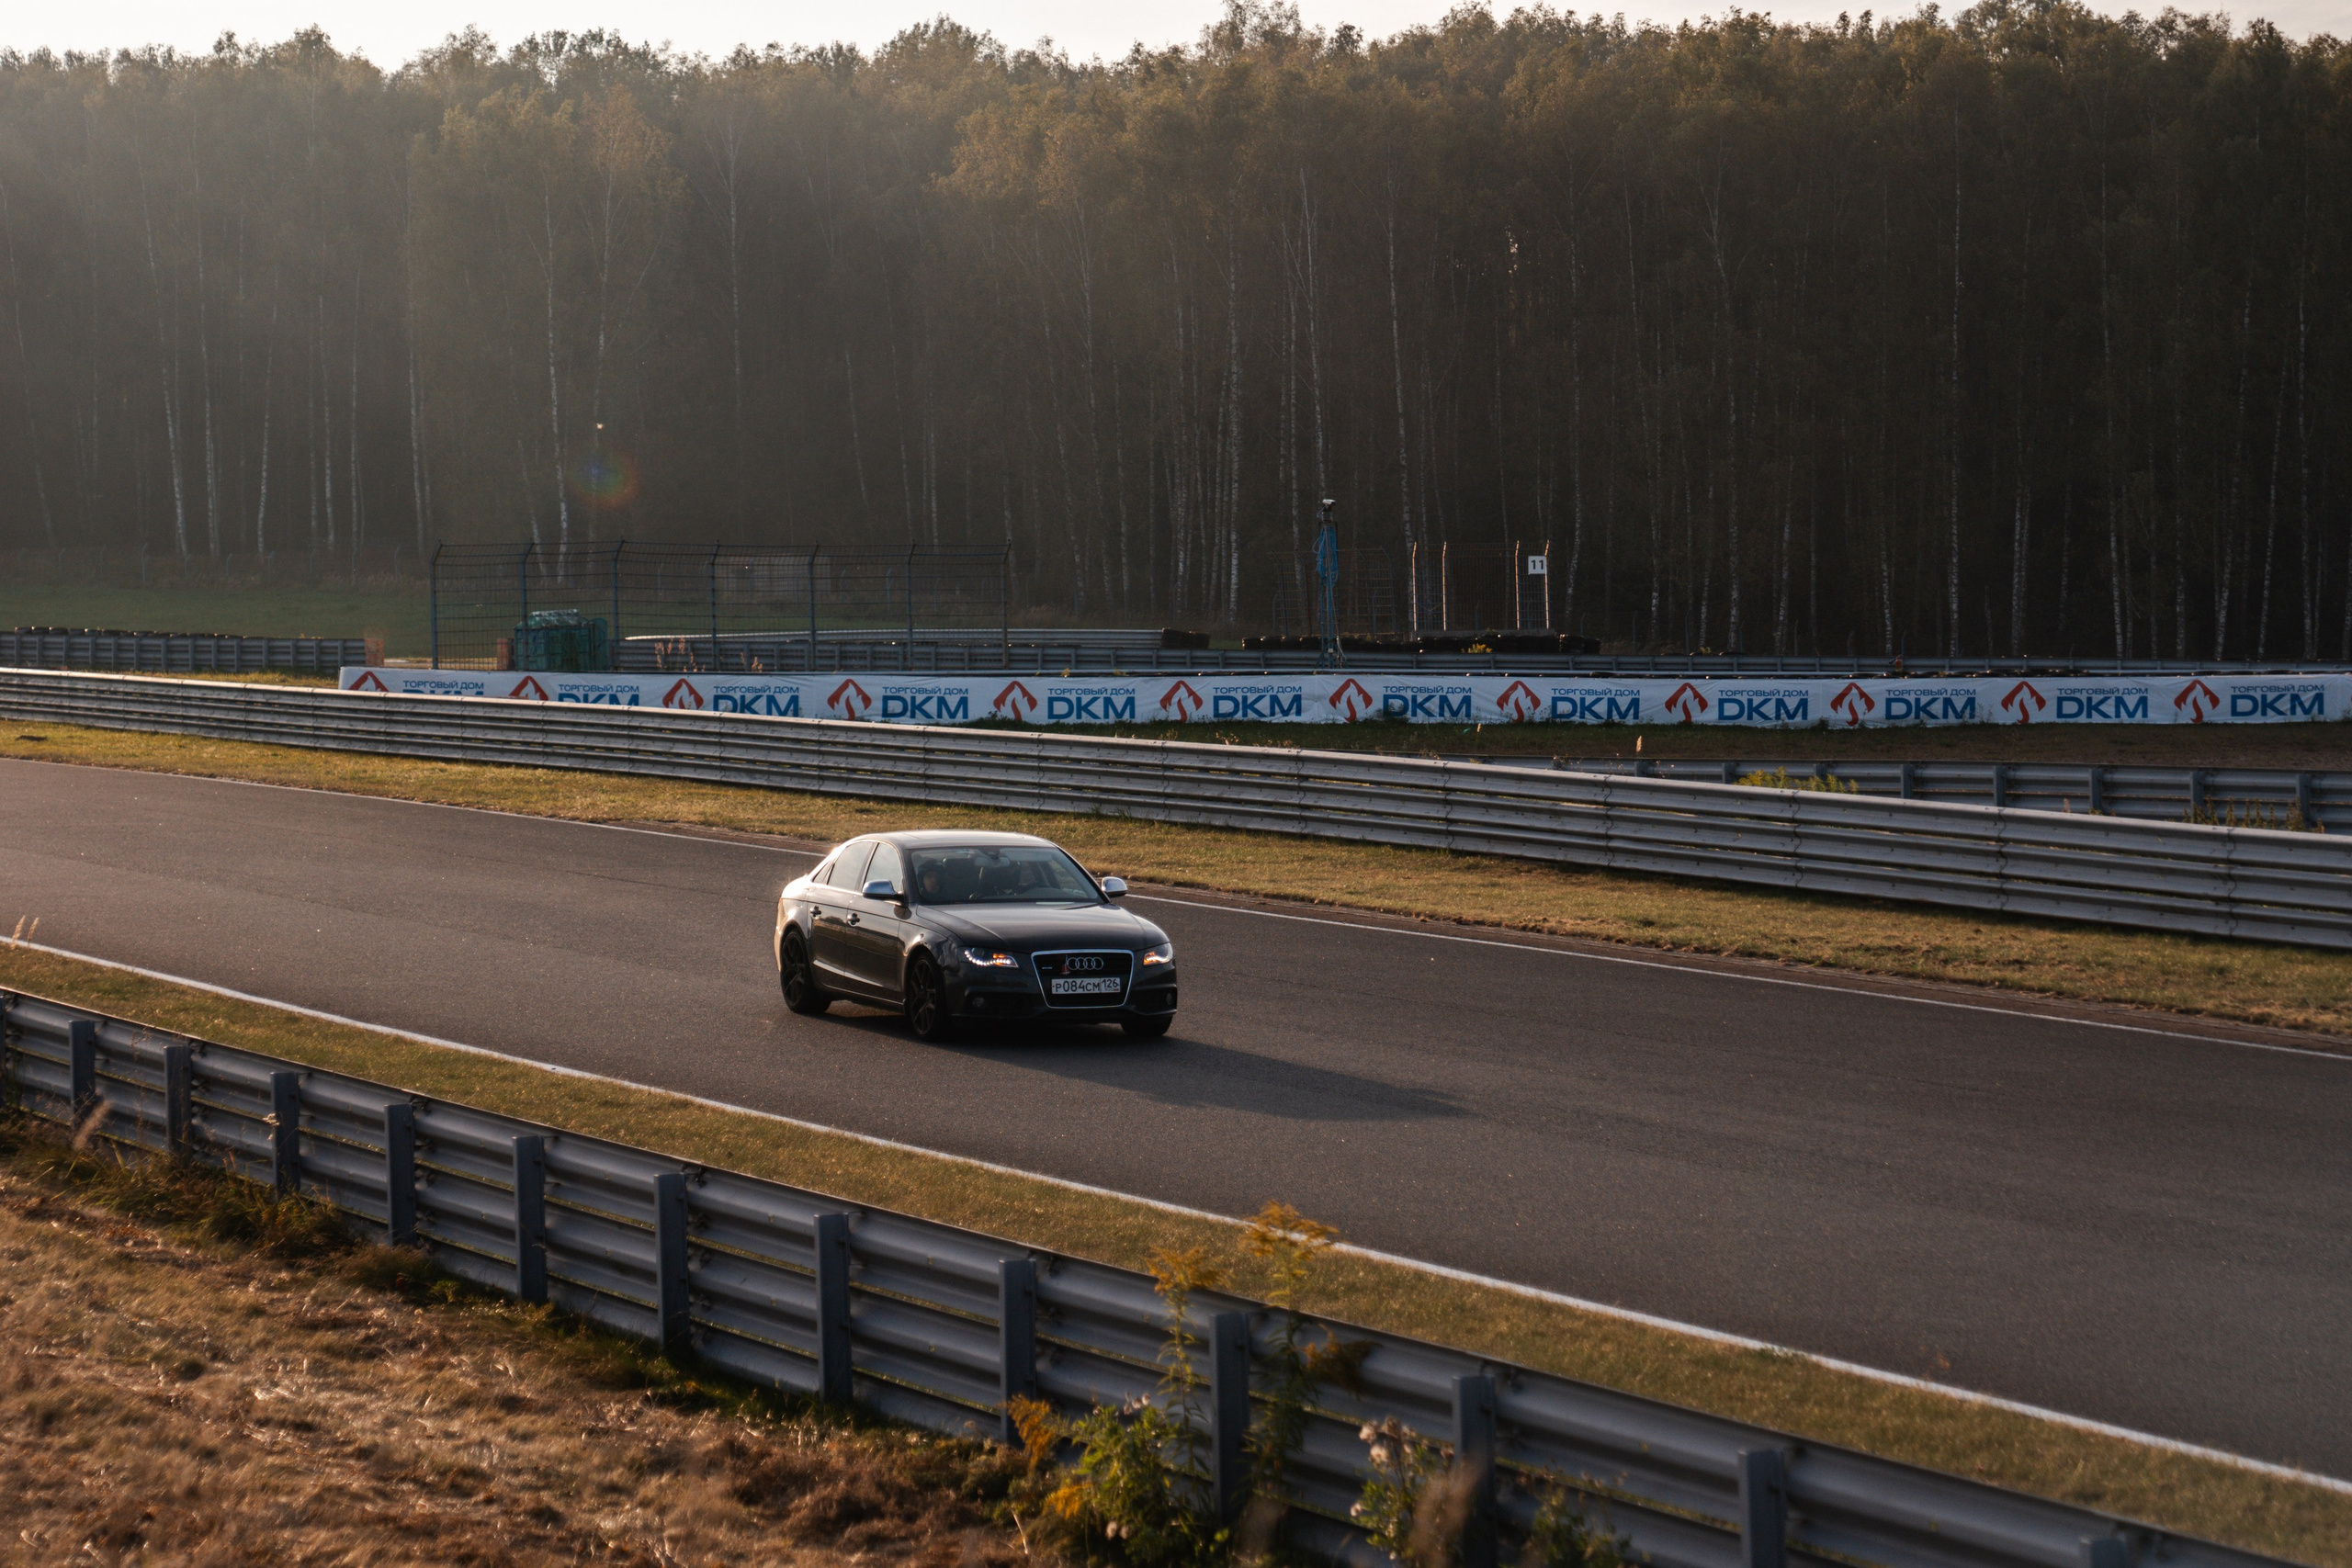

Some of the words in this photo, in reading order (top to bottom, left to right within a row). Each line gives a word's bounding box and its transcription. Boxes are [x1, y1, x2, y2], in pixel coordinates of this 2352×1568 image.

[1531, 559, 1544, 570] 11
[402, 680, 458, 689] ТОРГОВЫЙ
[460, 682, 484, 691] ДОМ
[558, 683, 614, 693] ТОРГОВЫЙ
[615, 684, 639, 694] ДОМ
[713, 685, 771, 694] ТОРГОВЫЙ
[882, 686, 941, 695] ТОРГОВЫЙ
[1213, 686, 1273, 694] ТОРГОВЫЙ
[1275, 686, 1302, 694] ДОМ
[1383, 685, 1444, 694] ТОРГОВЫЙ
[1446, 686, 1472, 694] ДОМ
[2231, 684, 2295, 694] ТОРГОВЫЙ
[2298, 684, 2324, 693] ДОМ
[1047, 687, 1107, 695] ТОРГОВЫЙ
[1110, 688, 1136, 696] ДОМ
[1551, 688, 1611, 696] ТОРГОВЫЙ
[1718, 689, 1780, 697] ТОРГОВЫЙ
[1885, 688, 1948, 696] ТОРГОВЫЙ
[2057, 687, 2120, 695] ТОРГОВЫЙ
[2122, 687, 2148, 696] ДОМ
[713, 695, 799, 716] DKM
[881, 695, 968, 719] DKM
[1047, 696, 1136, 719] DKM
[1213, 694, 1302, 717] DKM
[1383, 694, 1471, 717] DKM
[1551, 696, 1640, 720] DKM
[1718, 698, 1808, 721] DKM
[1885, 697, 1975, 720] DKM
[2056, 695, 2148, 719] DKM
[2230, 693, 2324, 717] DKM
[1102, 978, 1119, 988] 126
